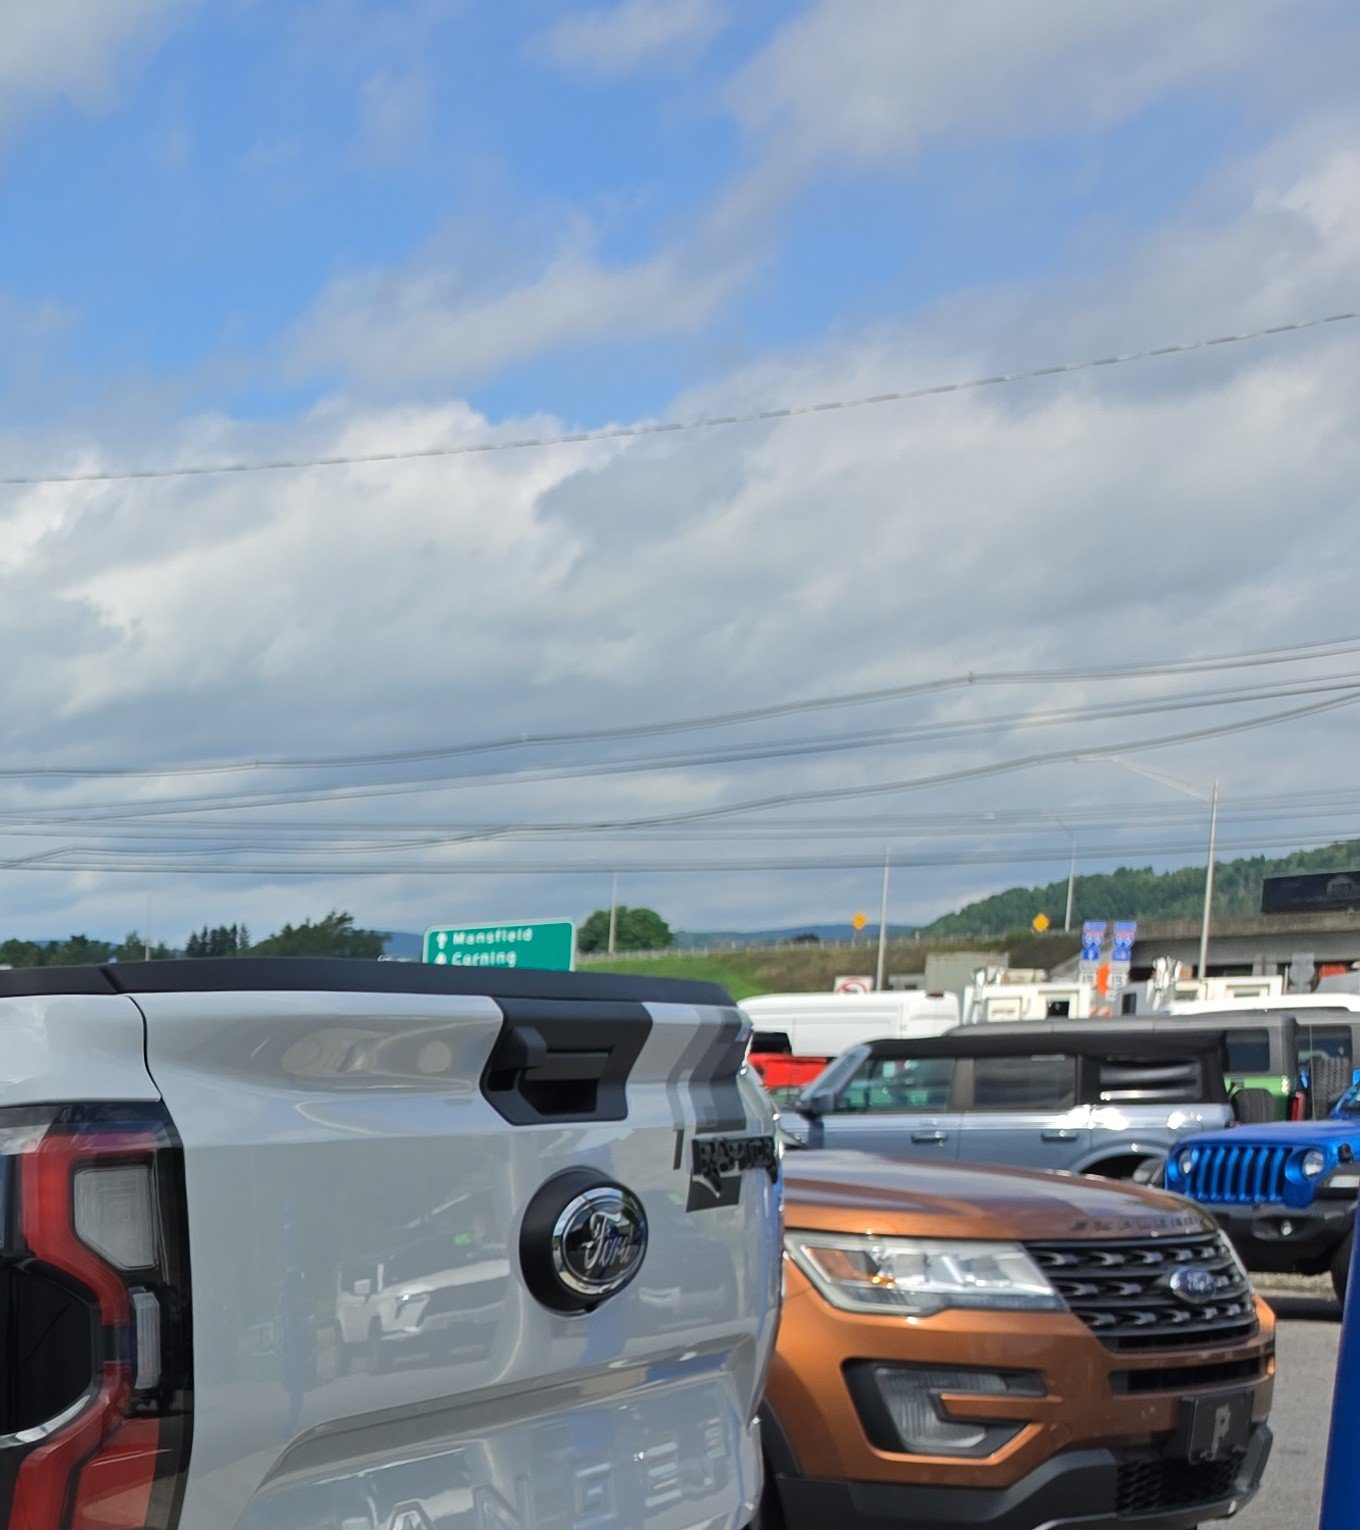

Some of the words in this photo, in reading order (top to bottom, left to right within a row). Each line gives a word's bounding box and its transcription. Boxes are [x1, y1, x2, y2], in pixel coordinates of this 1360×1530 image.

[452, 927, 534, 946] Mansfield
[451, 950, 518, 968] Corning
[581, 1211, 633, 1270] Ford
